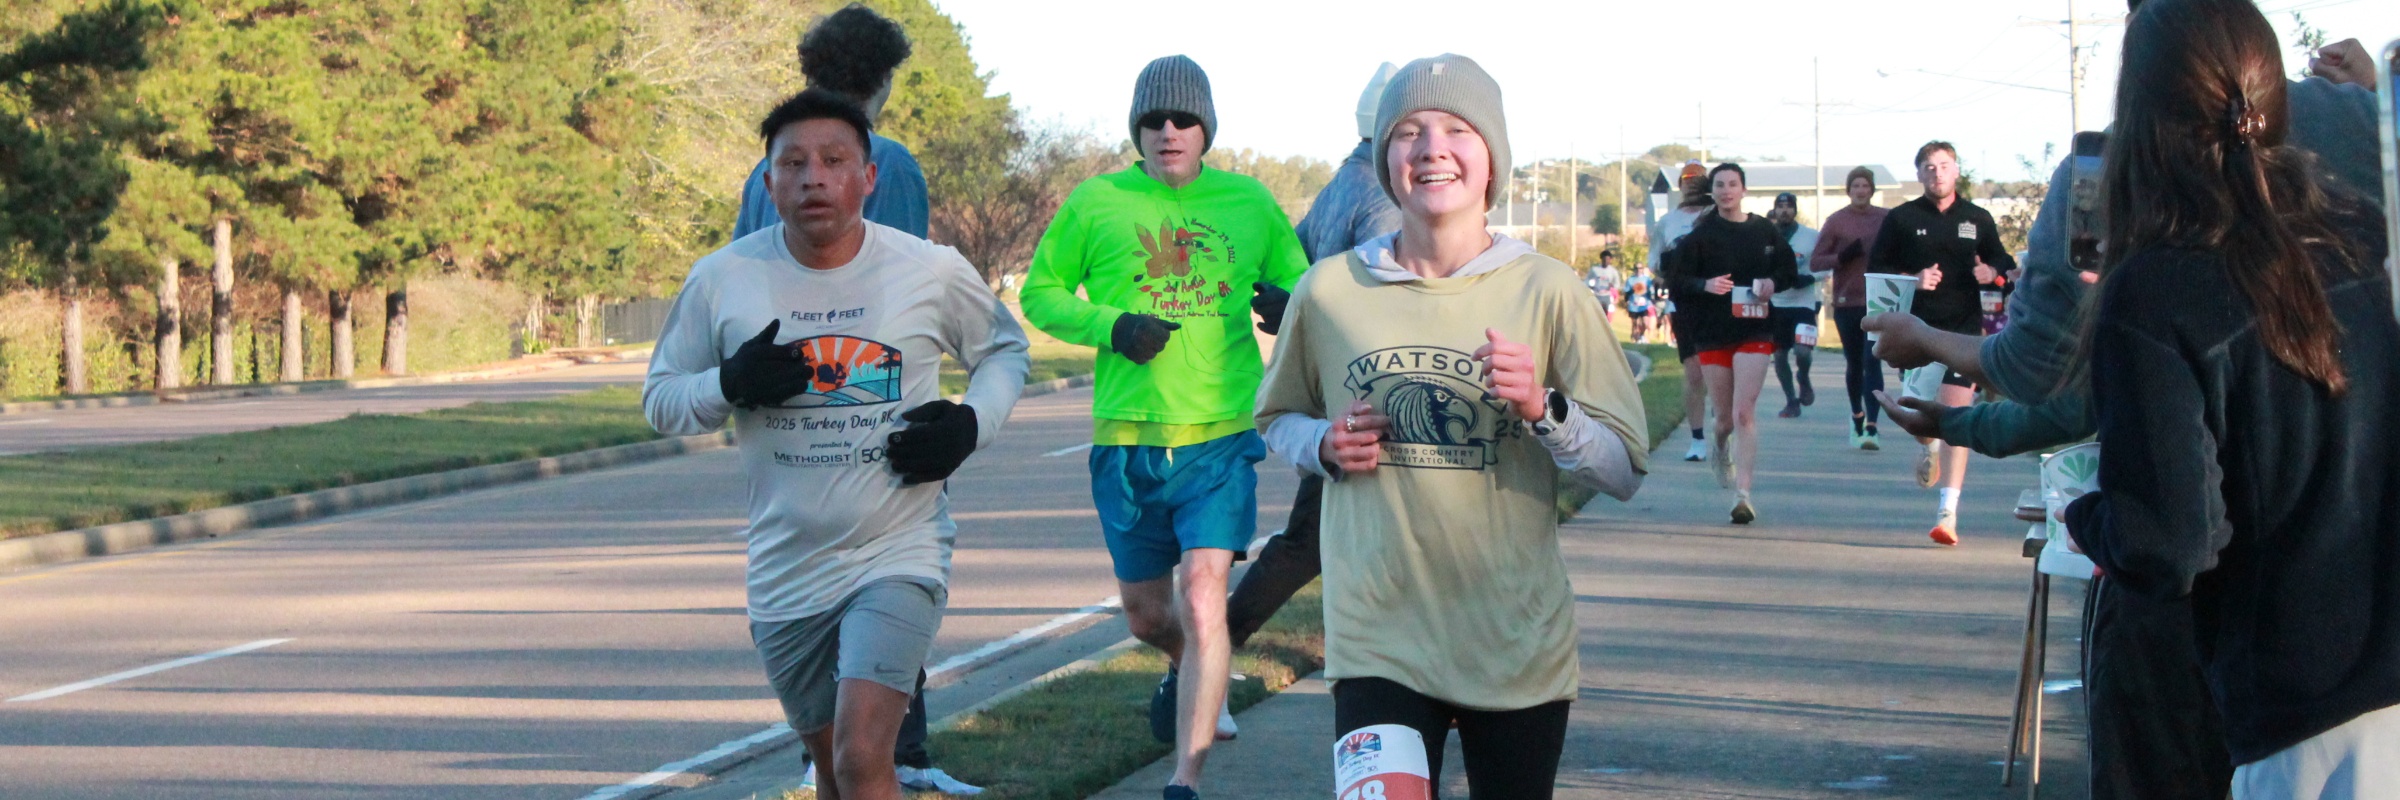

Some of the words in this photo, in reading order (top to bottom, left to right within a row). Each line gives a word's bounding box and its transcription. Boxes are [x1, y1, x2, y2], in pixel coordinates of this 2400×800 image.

[1150, 291, 1191, 311] Turkey
[1196, 290, 1216, 307] Day
[791, 311, 823, 321] FLEET
[838, 307, 865, 319] FEET
[765, 416, 796, 430] 2025
[801, 416, 846, 434] Turkey
[850, 414, 877, 430] Day
[880, 408, 896, 424] 8K
[809, 441, 842, 450] presented
[843, 441, 853, 450] by
[1383, 445, 1417, 456] CROSS
[1422, 448, 1474, 458] COUNTRY
[774, 451, 851, 463] METHODIST
[1390, 453, 1466, 466] INVITATIONAL
